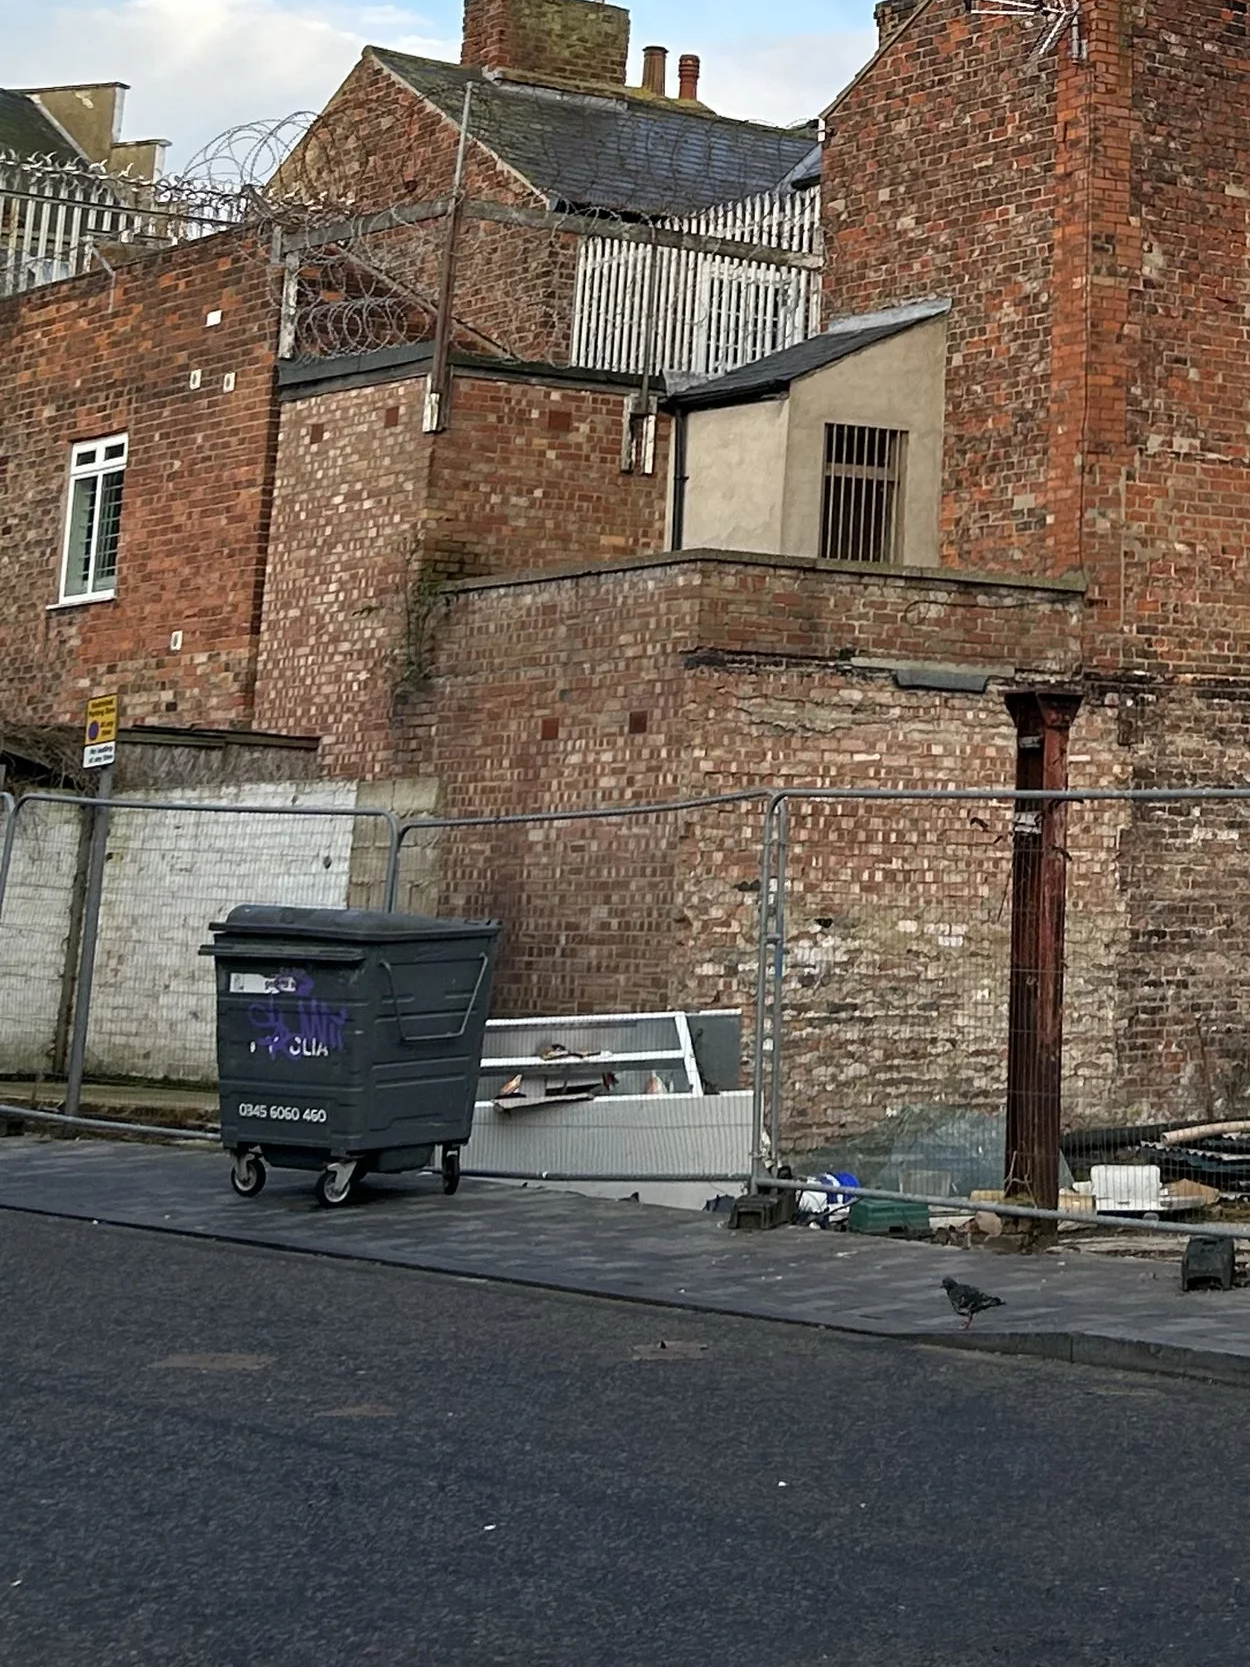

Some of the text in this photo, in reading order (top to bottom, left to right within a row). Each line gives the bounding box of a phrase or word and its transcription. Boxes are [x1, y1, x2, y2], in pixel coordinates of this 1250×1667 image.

[239, 1103, 327, 1123] 0345 6060 460
